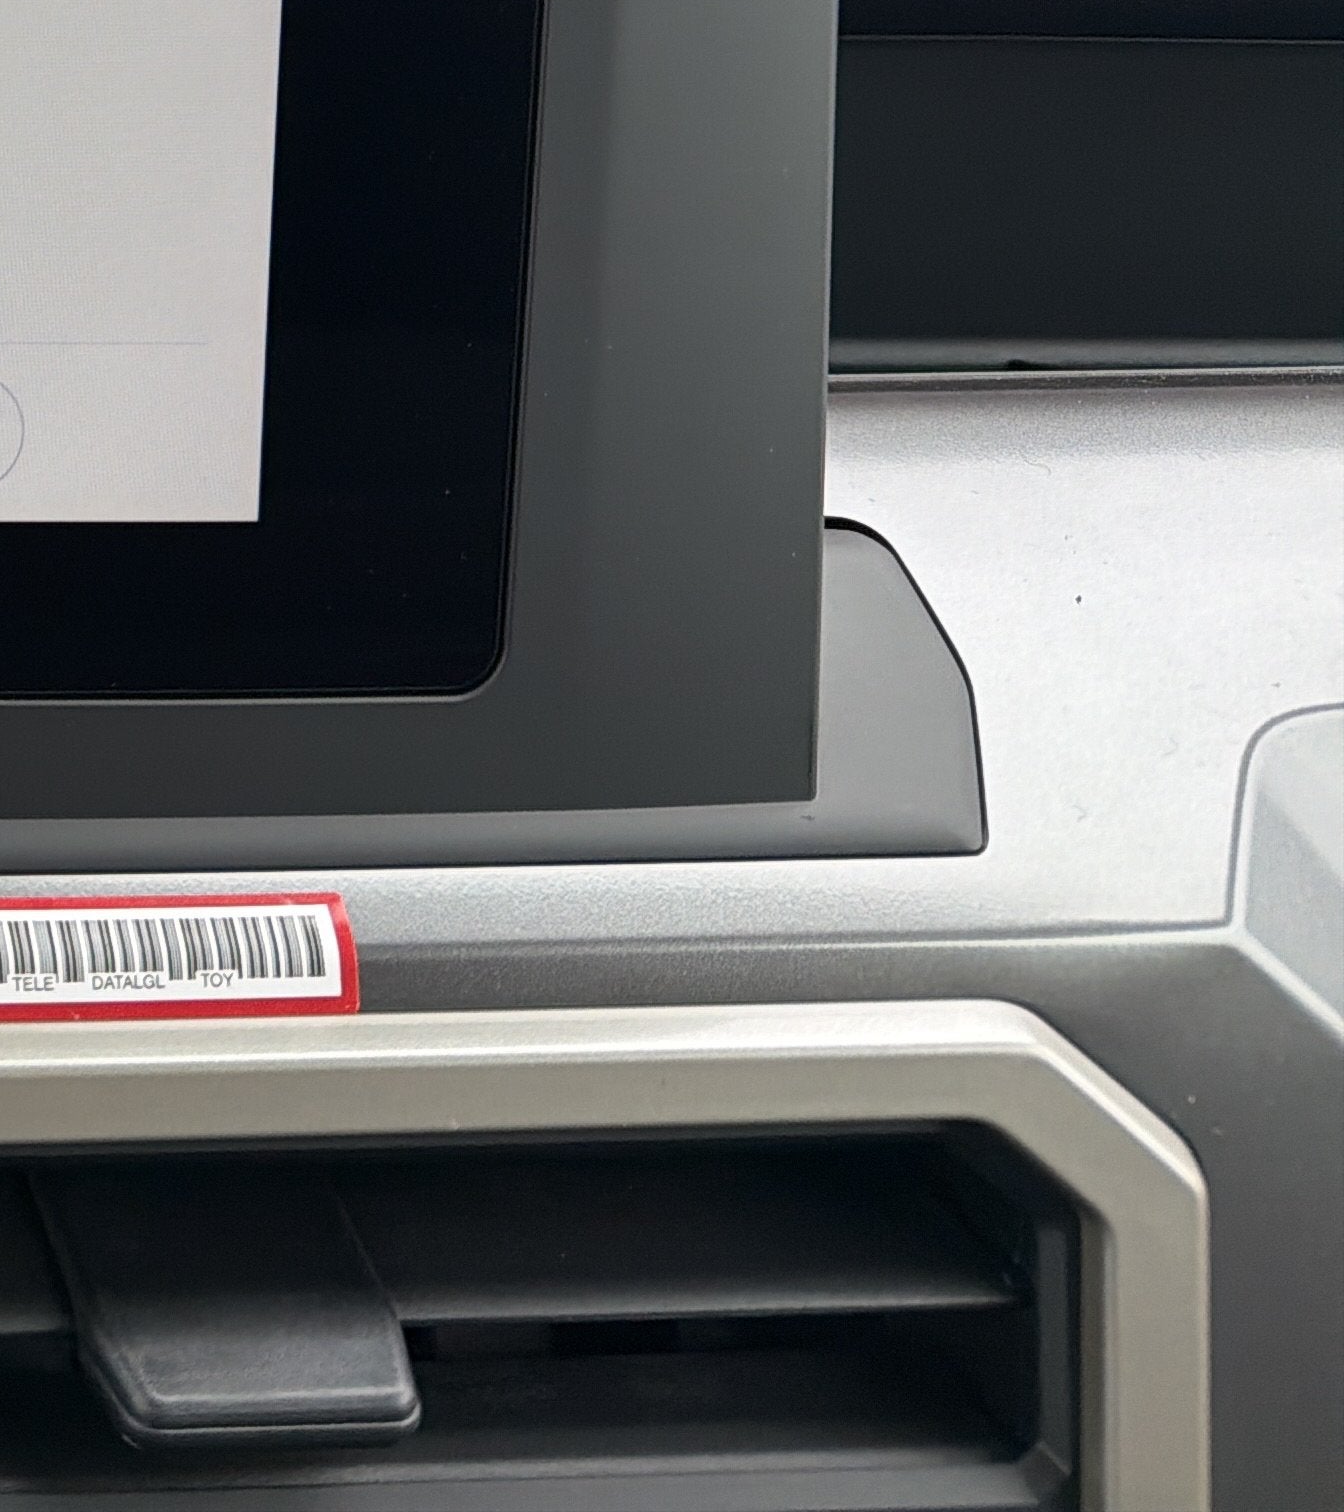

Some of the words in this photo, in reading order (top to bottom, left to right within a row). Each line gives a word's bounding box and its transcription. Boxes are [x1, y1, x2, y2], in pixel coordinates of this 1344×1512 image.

[13, 976, 54, 991] TELE
[92, 974, 165, 990] DATALGL
[201, 972, 234, 987] TOY
